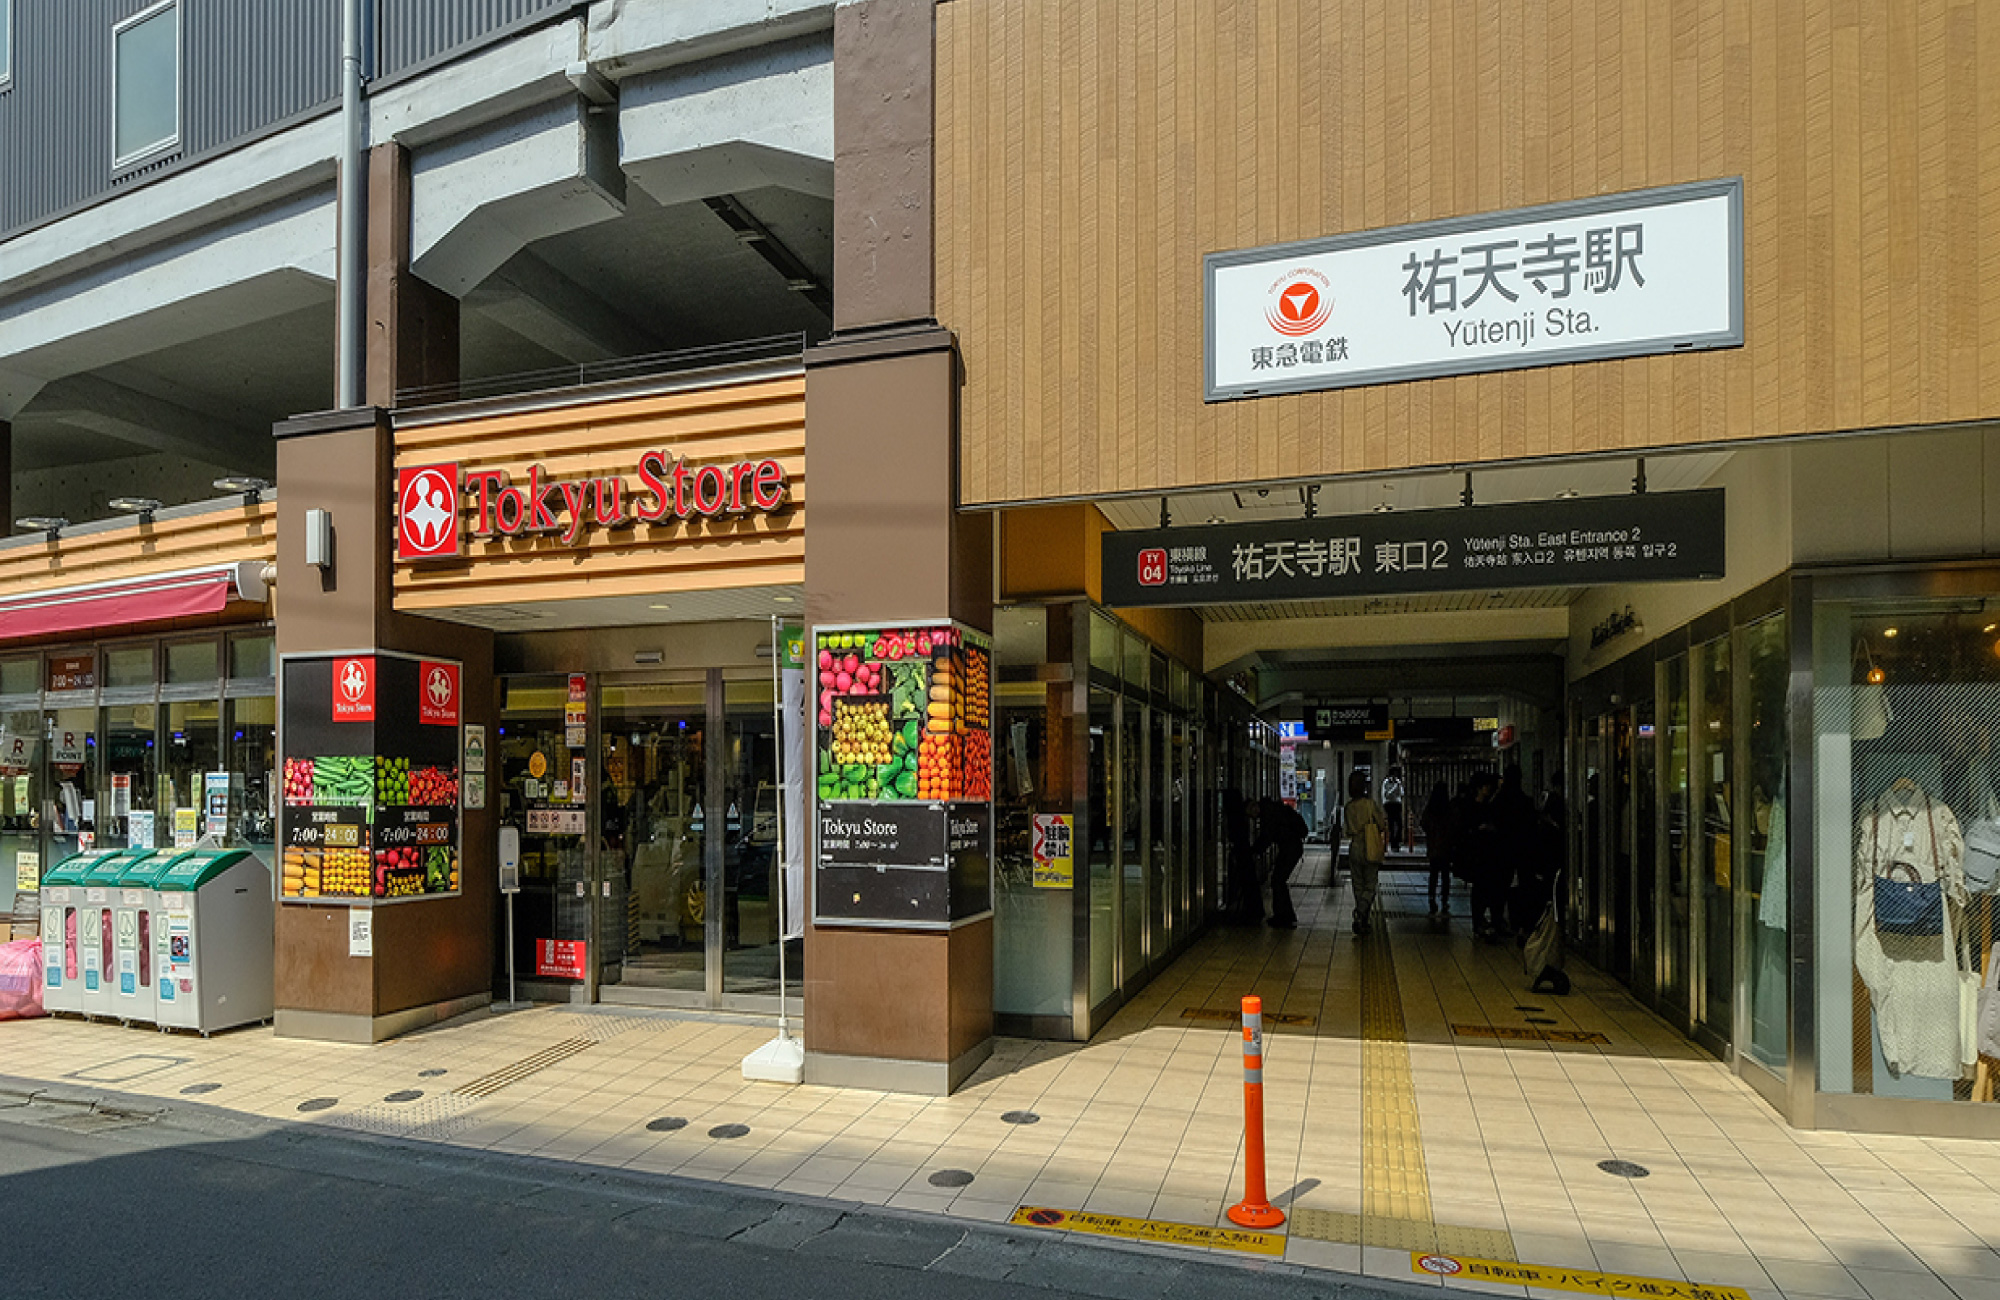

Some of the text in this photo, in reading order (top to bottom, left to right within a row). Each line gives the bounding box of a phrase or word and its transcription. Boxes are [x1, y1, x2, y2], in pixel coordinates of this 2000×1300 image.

[1402, 223, 1646, 317] 祐天寺駅
[1545, 307, 1600, 337] Sta.
[1250, 336, 1349, 370] 東急電鉄
[465, 449, 786, 546] Tokyu Store
[1508, 533, 1534, 549] Sta.
[1537, 531, 1567, 546] East
[1570, 529, 1628, 545] Entrance
[1631, 526, 1641, 541] 2
[1146, 552, 1160, 564] TY
[1231, 536, 1361, 582] 祐天寺駅
[1374, 540, 1449, 573] 東口2
[1142, 564, 1162, 582] 04
[822, 818, 898, 838] Tokyu Store
